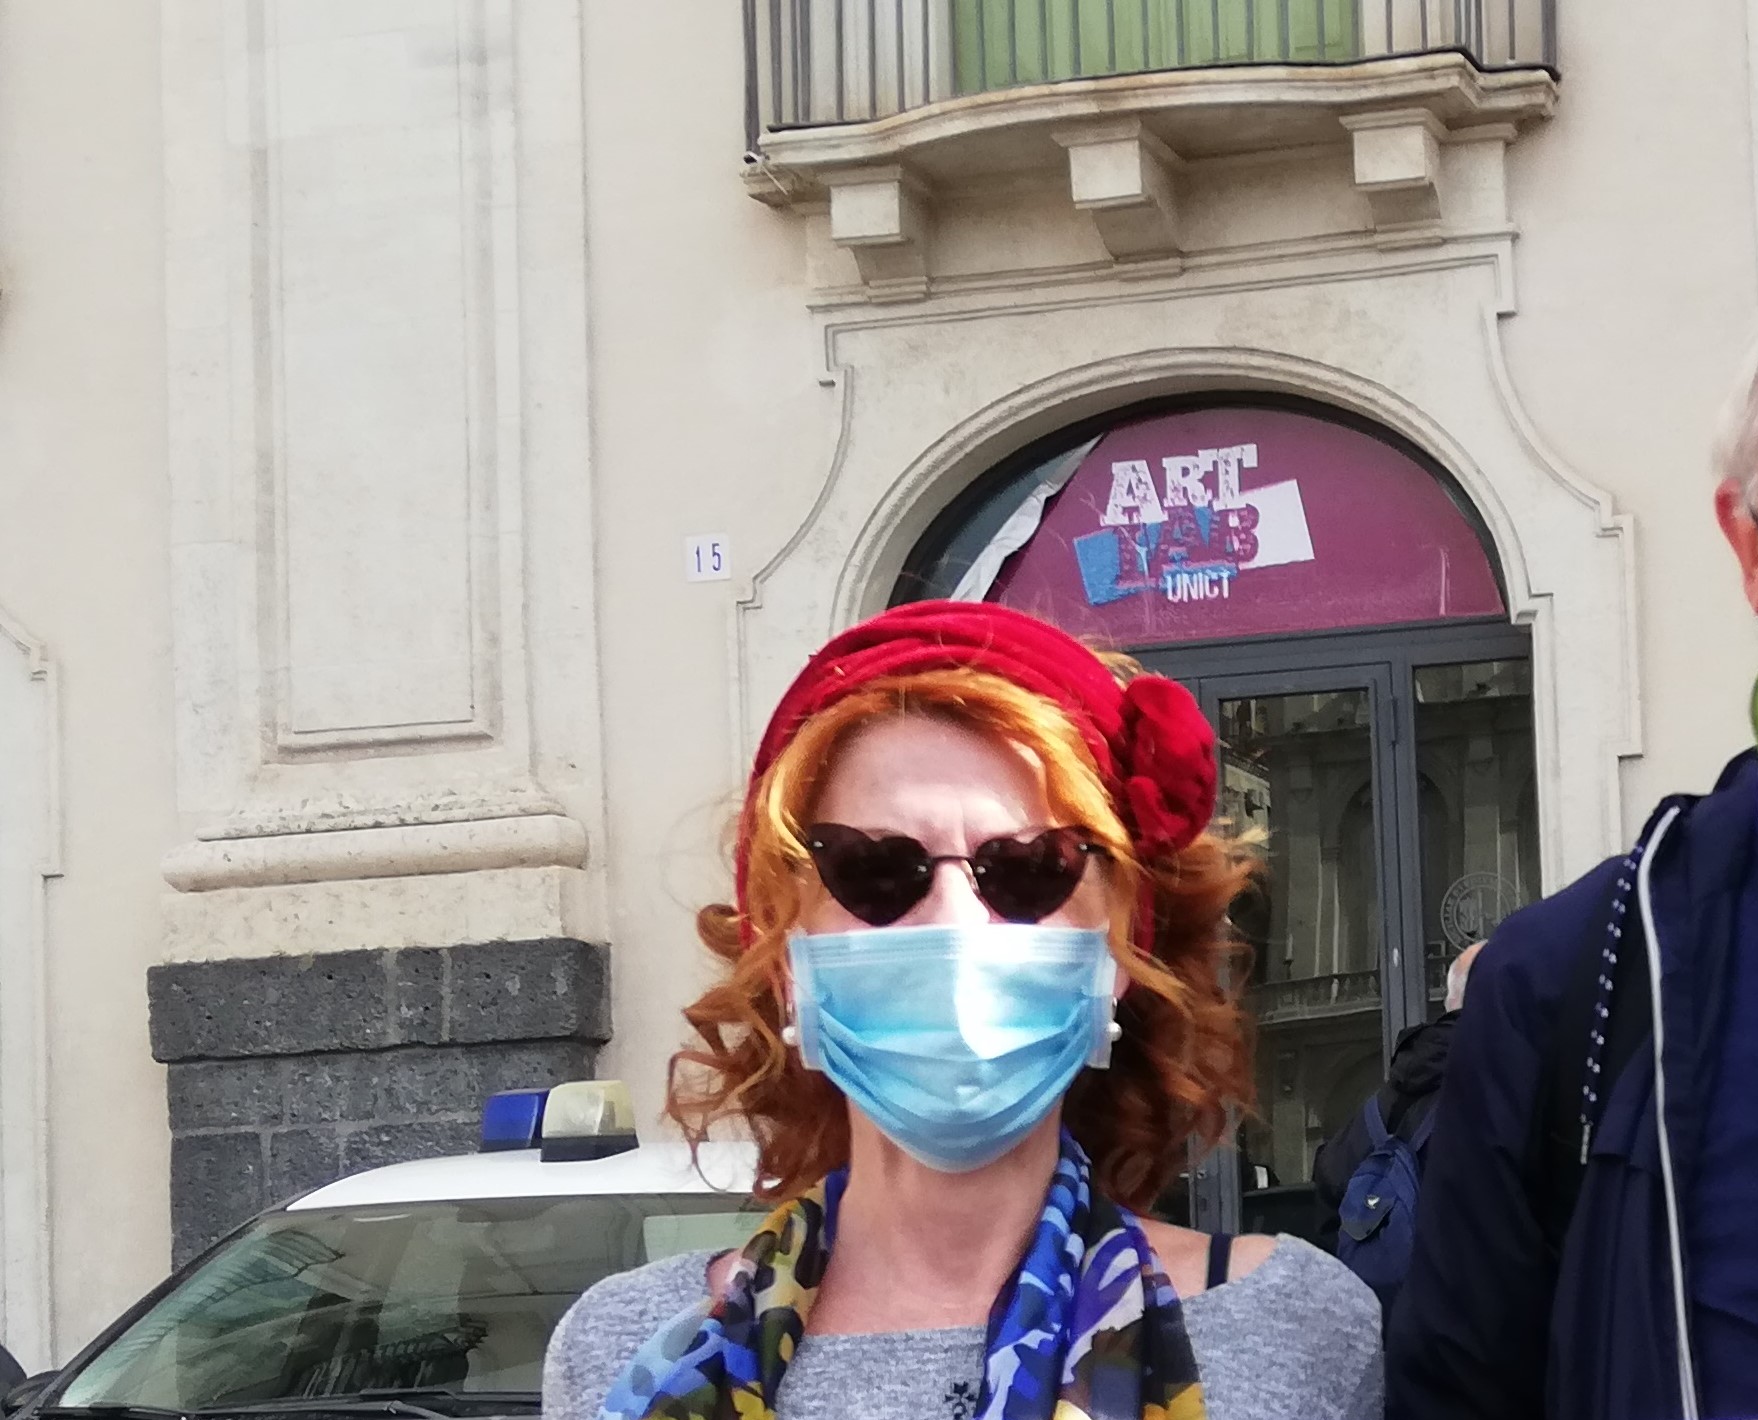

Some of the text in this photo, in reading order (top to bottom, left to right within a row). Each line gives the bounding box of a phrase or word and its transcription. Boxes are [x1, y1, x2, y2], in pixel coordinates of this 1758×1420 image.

[1101, 443, 1258, 526] ART
[696, 543, 721, 573] 15
[1164, 570, 1231, 602] UNICT
